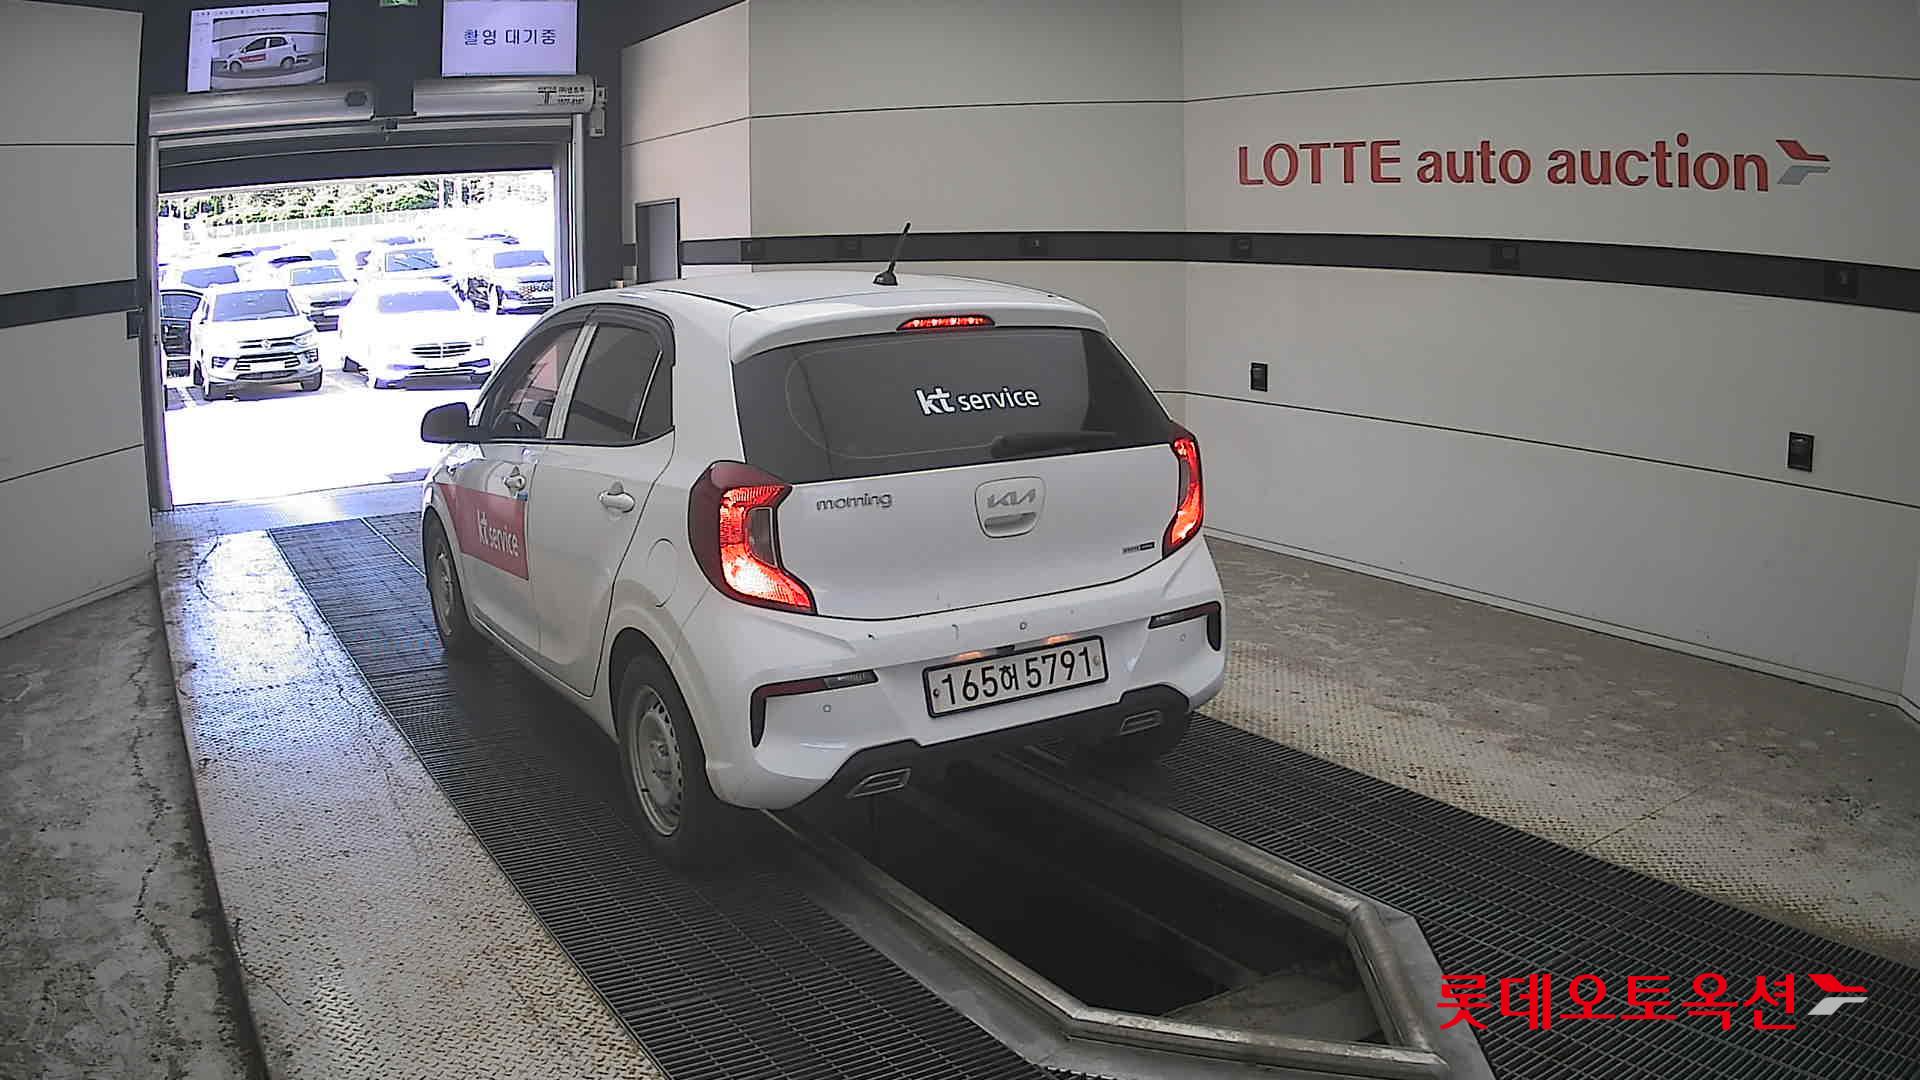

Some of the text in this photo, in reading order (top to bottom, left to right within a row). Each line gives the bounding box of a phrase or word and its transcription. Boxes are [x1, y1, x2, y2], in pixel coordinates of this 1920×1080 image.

[464, 28, 557, 46] 촬영 대기중
[1239, 132, 1769, 192] LOTTE auto auction
[915, 386, 1041, 416] kt service
[816, 492, 893, 511] morning
[476, 507, 519, 557] kt service
[941, 646, 1093, 705] 165허 5791
